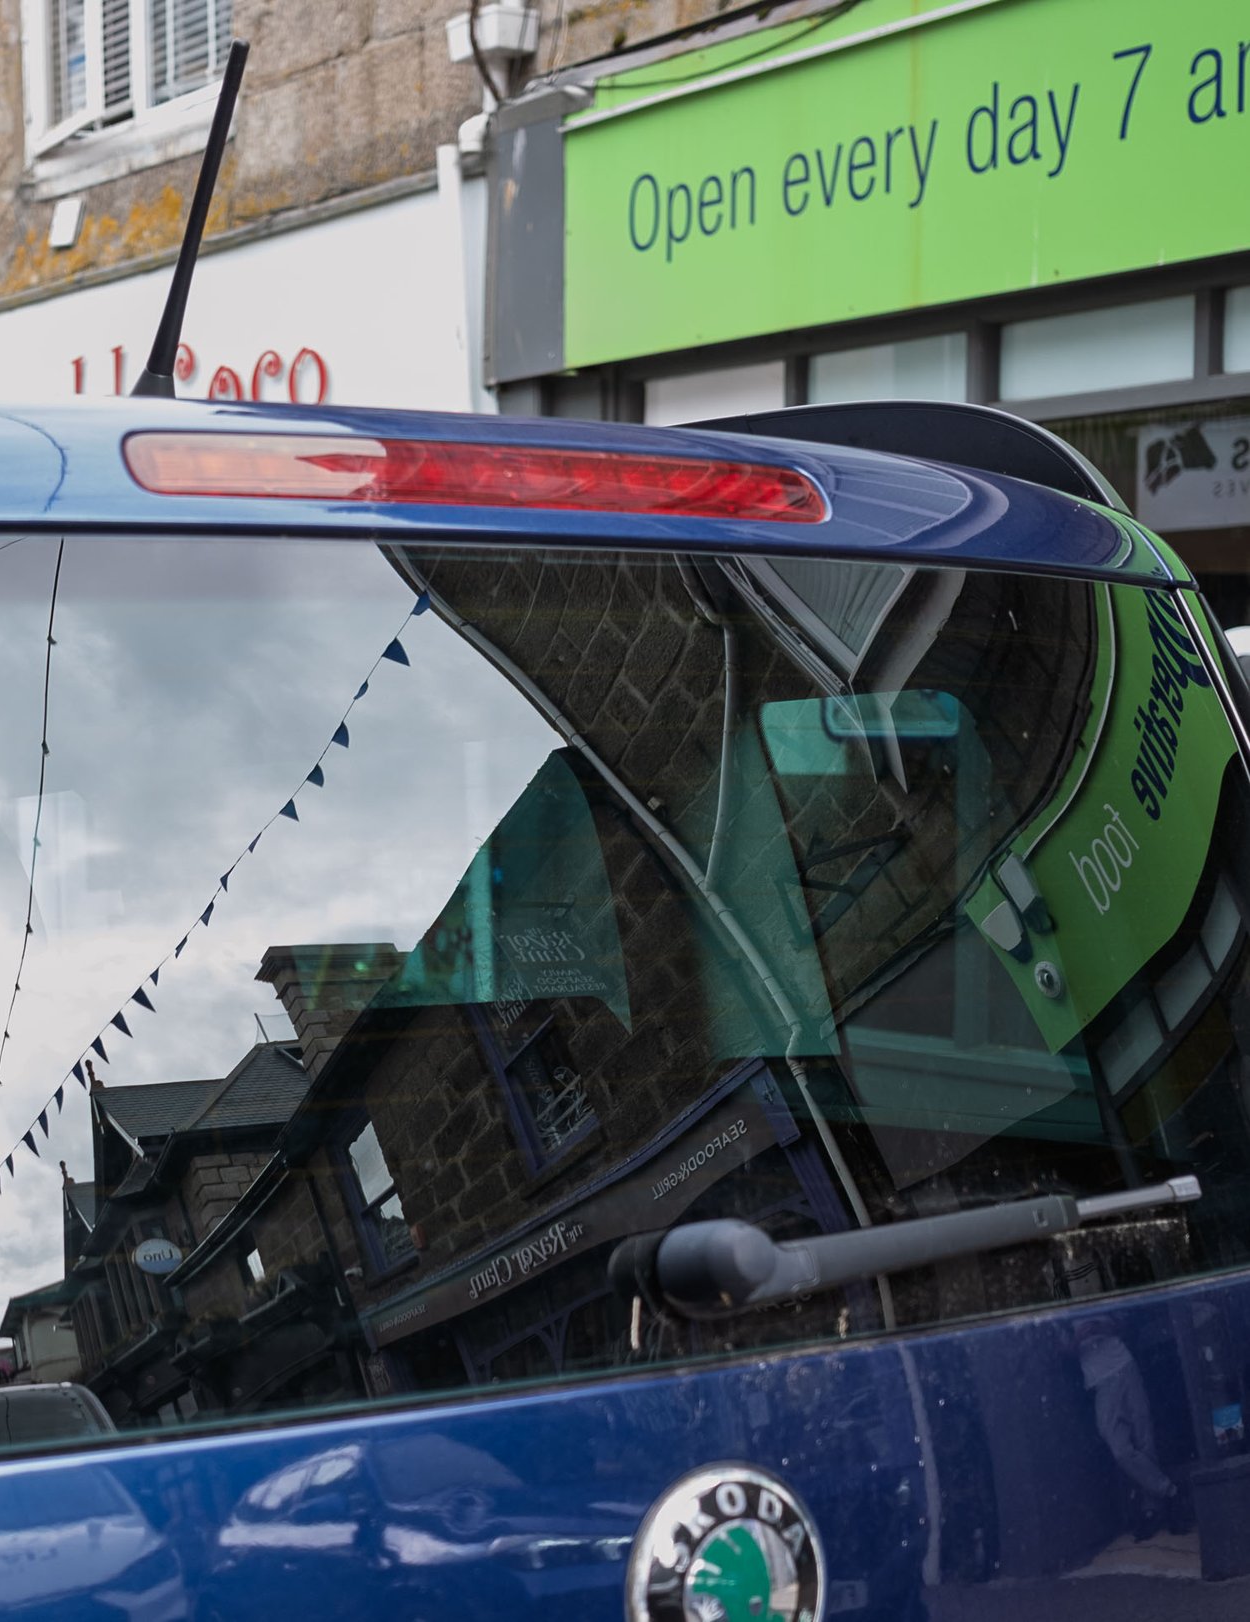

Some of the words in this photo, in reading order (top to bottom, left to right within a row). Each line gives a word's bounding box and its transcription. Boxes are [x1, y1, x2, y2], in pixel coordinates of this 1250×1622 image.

[628, 165, 757, 262] Open
[782, 119, 938, 216] every
[965, 81, 1080, 180] day
[1112, 43, 1153, 141] 7
